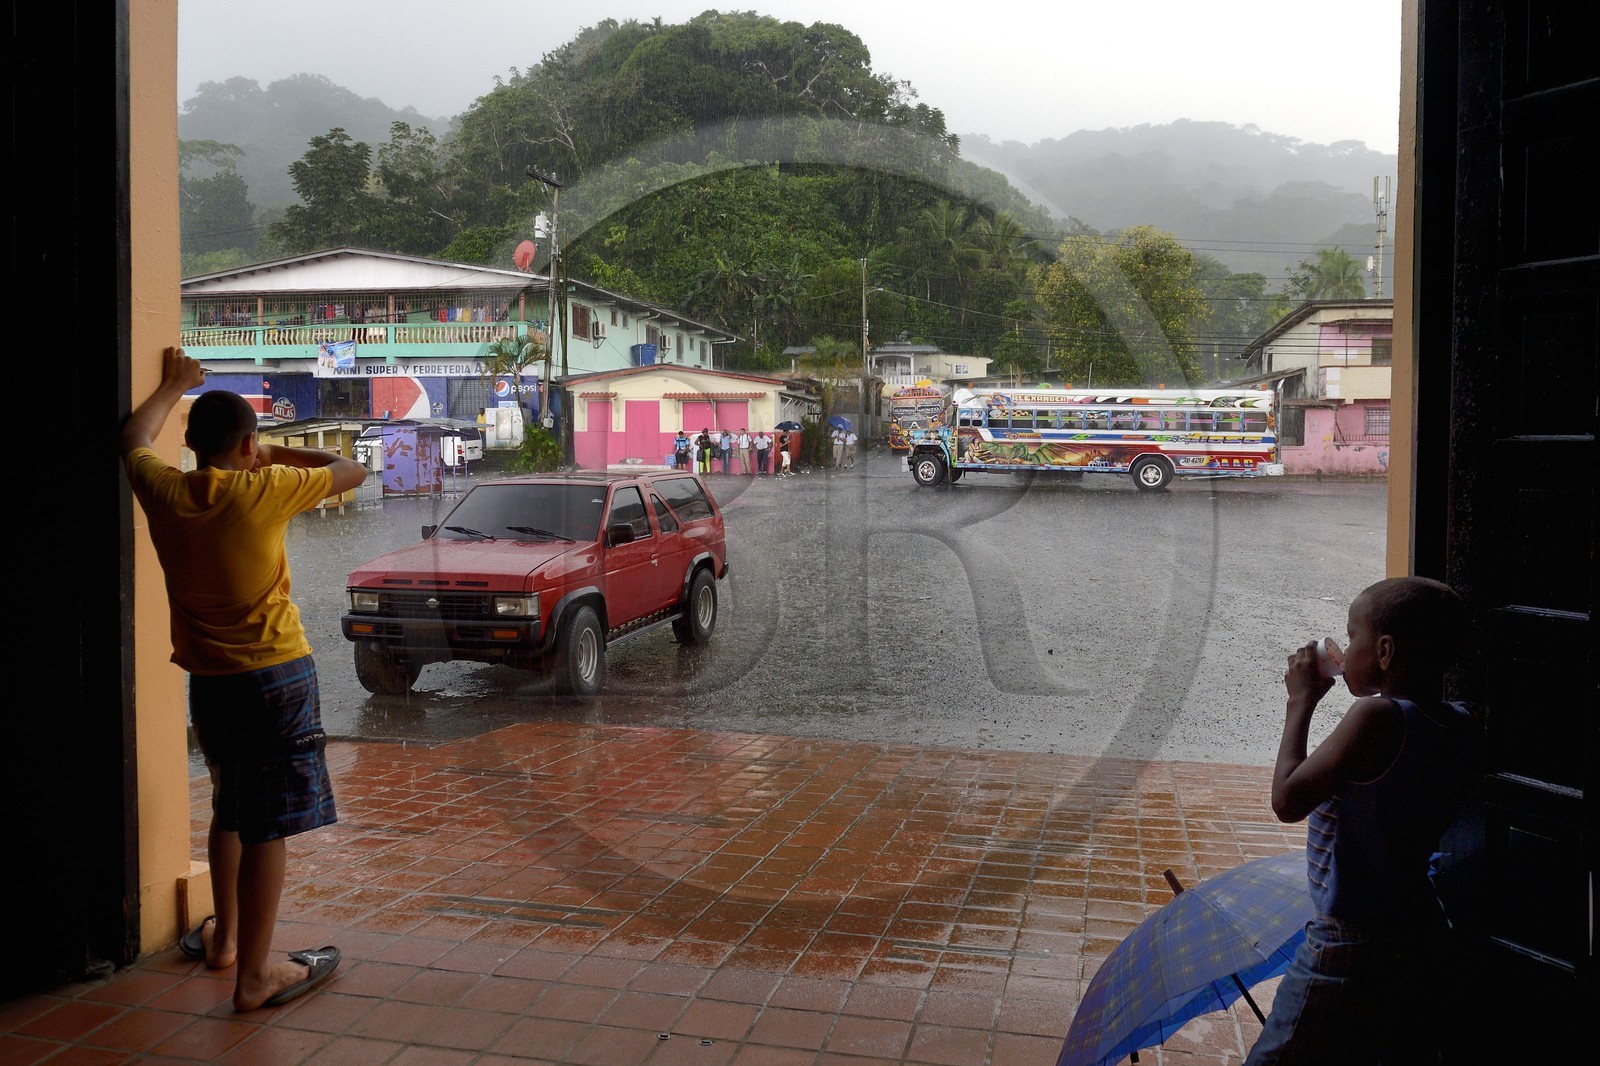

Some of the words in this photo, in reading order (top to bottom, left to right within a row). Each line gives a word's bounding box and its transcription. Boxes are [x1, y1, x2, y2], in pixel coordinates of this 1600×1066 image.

[332, 366, 361, 375] MINI
[366, 365, 398, 375] SUPER
[402, 365, 409, 374] Y
[413, 364, 471, 374] FERRETERIA
[511, 383, 537, 395] pepsi
[274, 406, 294, 418] ATLAS
